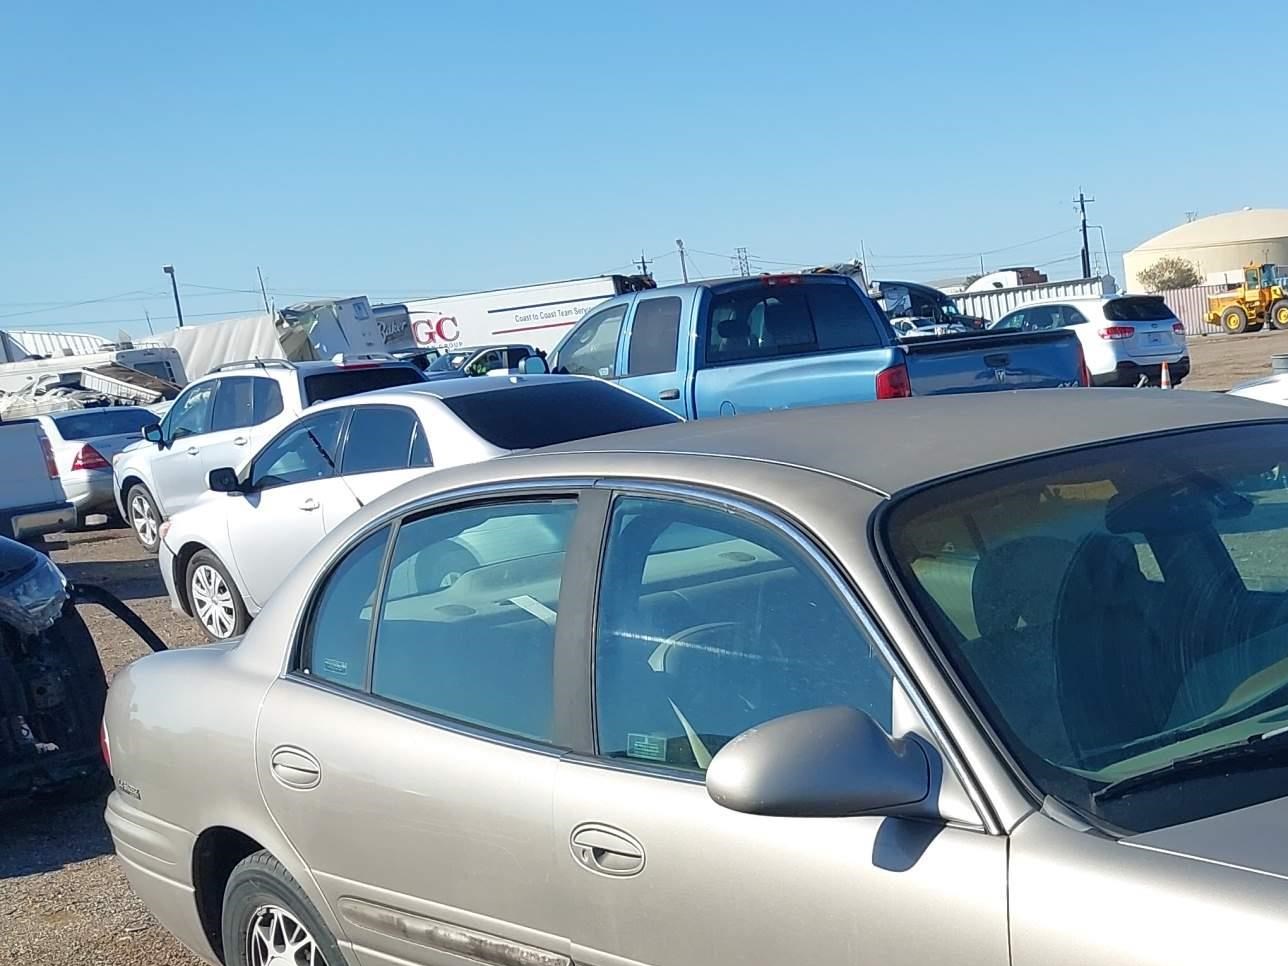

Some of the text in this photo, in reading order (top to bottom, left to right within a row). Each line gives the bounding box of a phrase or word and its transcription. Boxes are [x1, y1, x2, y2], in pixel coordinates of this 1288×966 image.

[514, 314, 532, 323] Coast
[540, 311, 557, 320] Coast
[558, 309, 573, 318] Team
